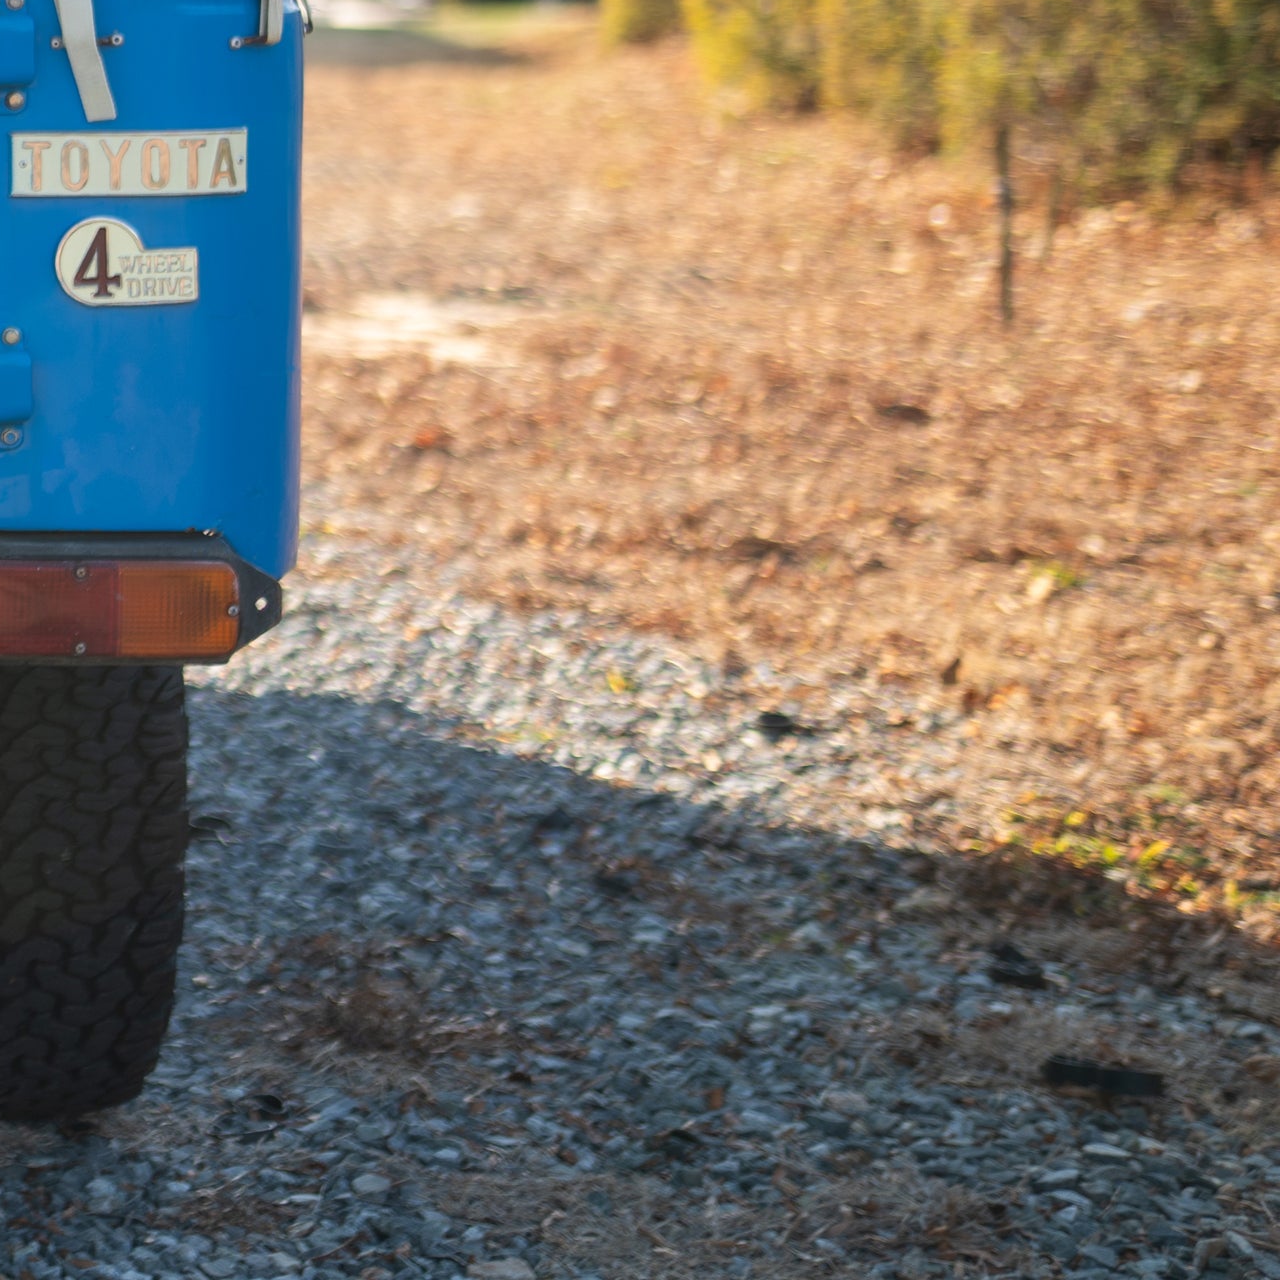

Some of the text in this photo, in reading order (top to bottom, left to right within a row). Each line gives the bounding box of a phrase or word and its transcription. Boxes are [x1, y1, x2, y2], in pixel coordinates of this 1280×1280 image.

[23, 138, 237, 191] TOYOTA
[73, 226, 122, 298] 4
[118, 254, 193, 274] WHEEL
[126, 276, 194, 298] DRIVE
